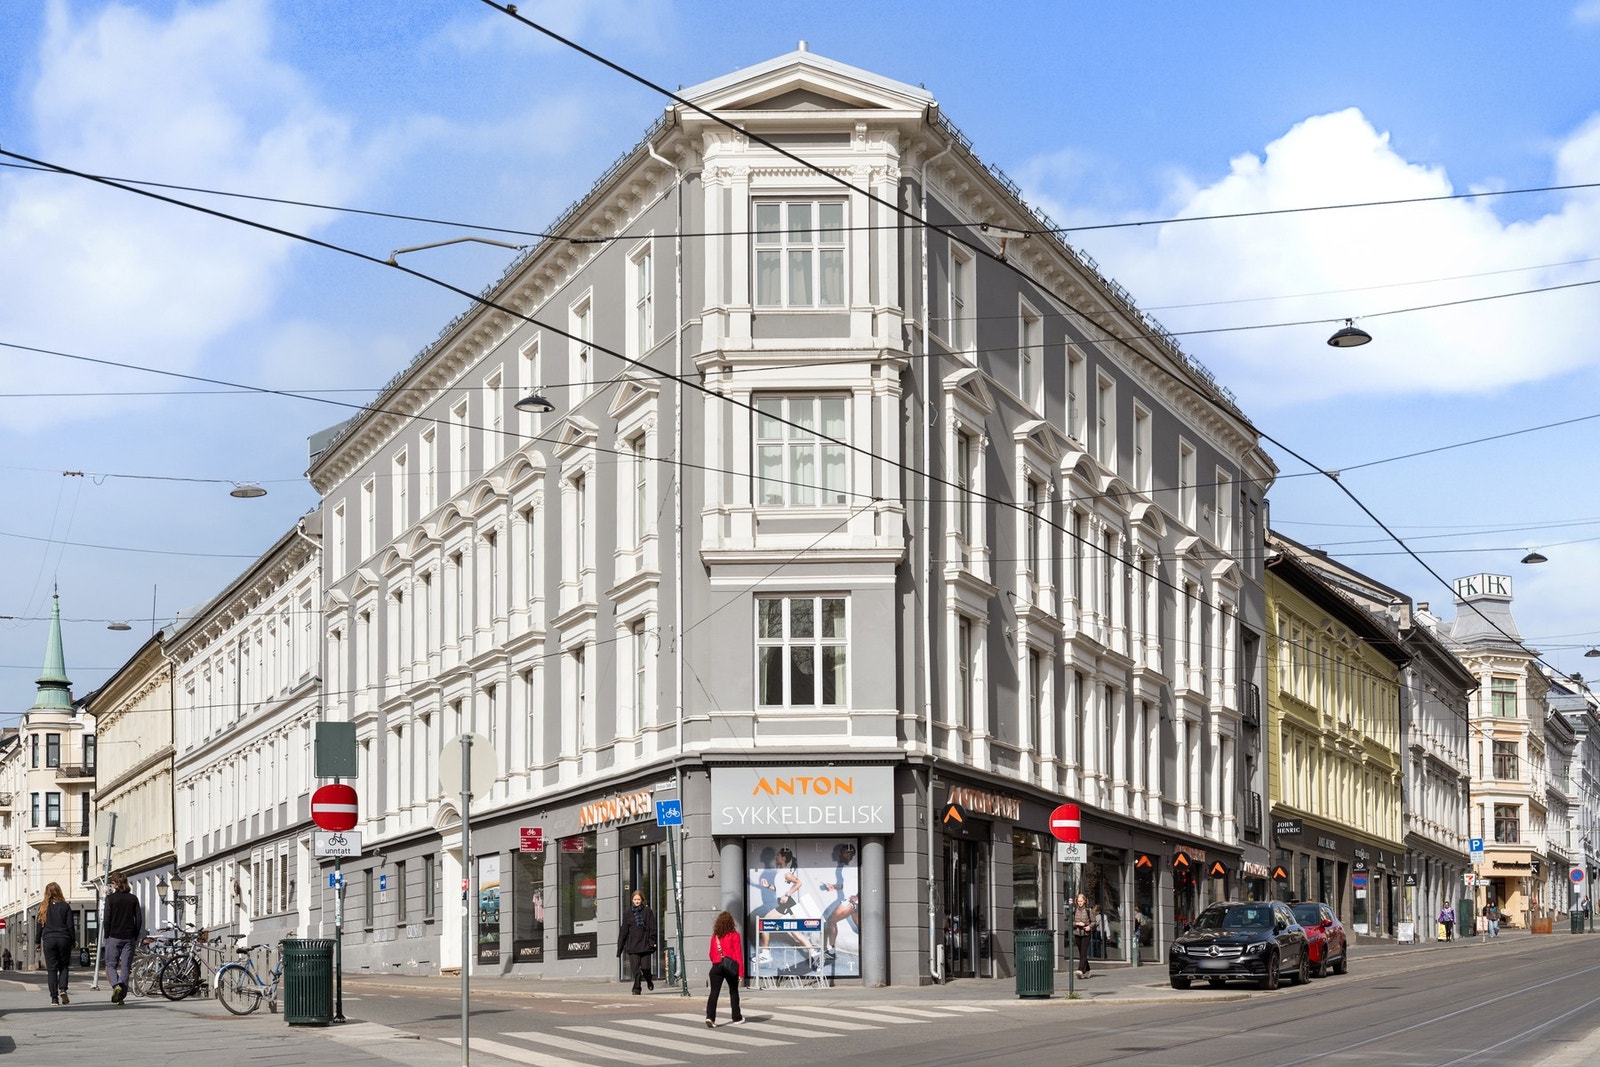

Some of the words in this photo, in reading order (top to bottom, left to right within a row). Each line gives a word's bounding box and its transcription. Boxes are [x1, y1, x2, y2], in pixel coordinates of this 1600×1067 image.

[1458, 577, 1478, 596] HK
[1488, 576, 1507, 595] HK
[753, 777, 853, 796] ANTON
[722, 805, 884, 825] SYKKELDELISK
[1472, 840, 1480, 850] P
